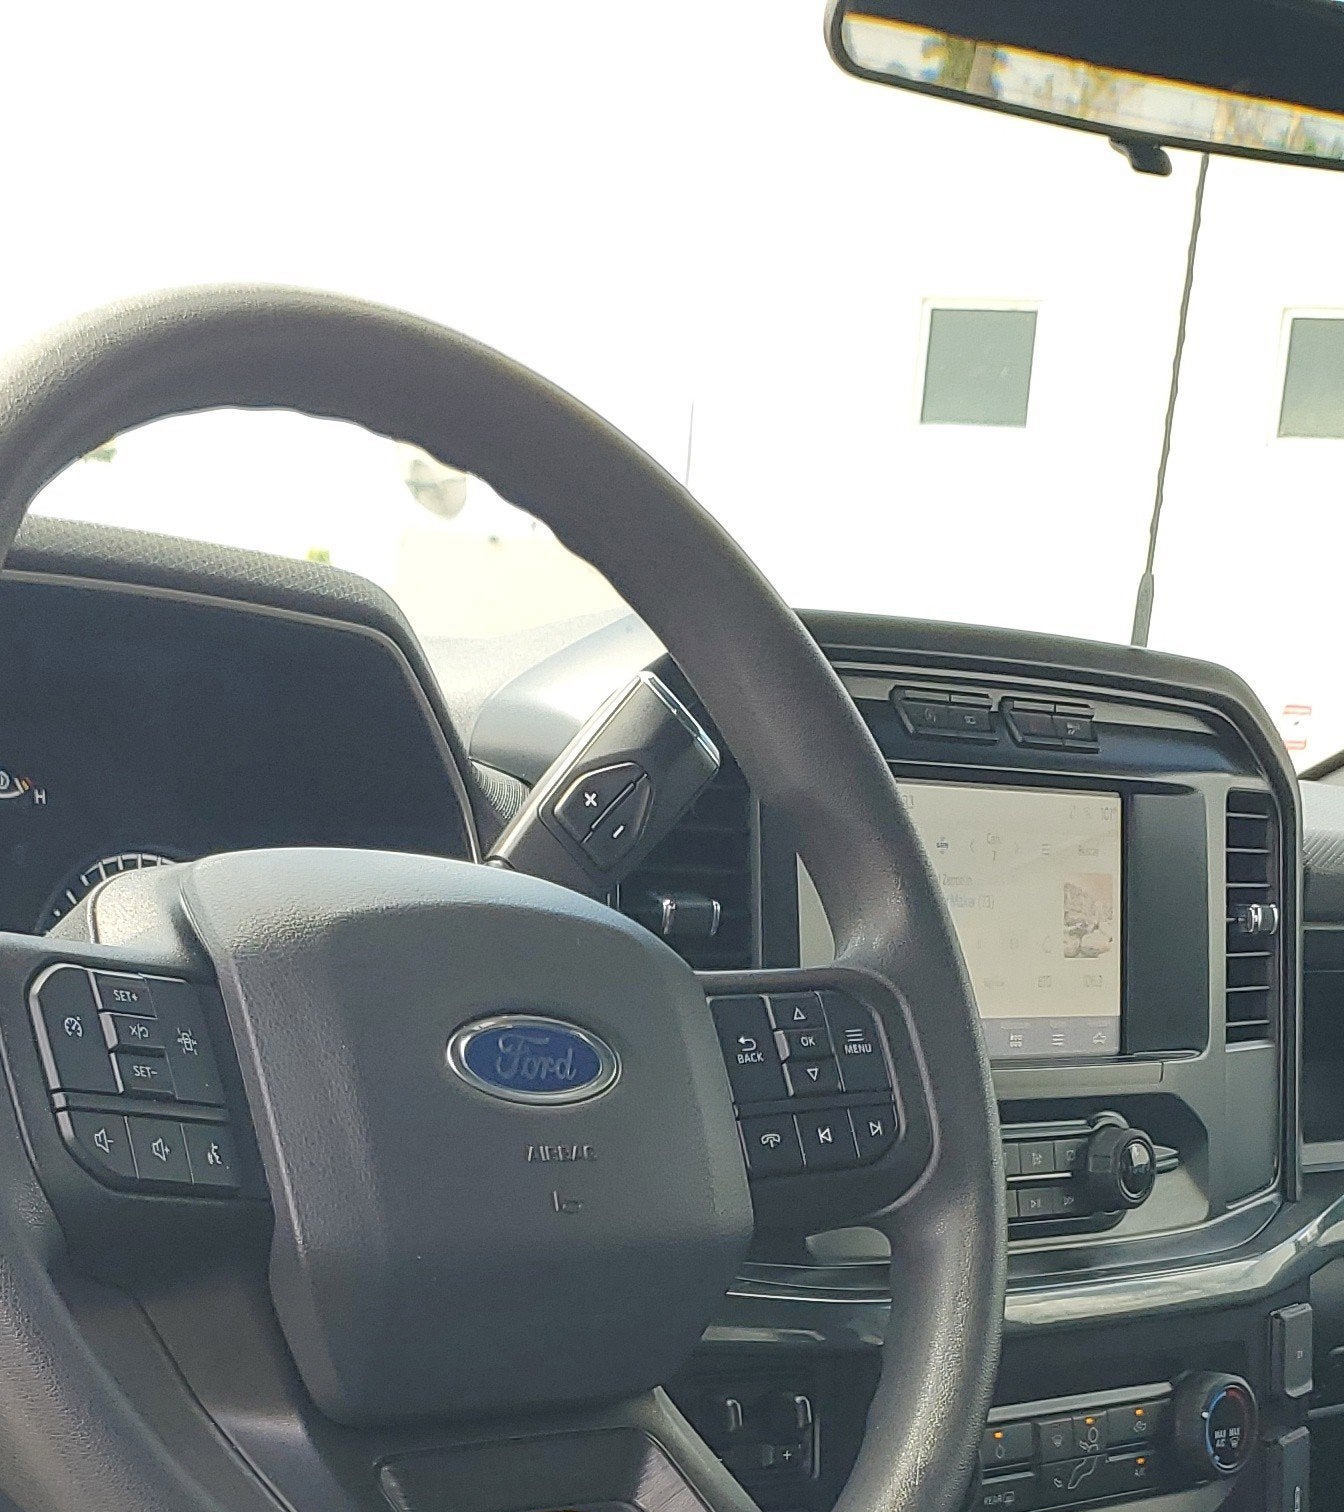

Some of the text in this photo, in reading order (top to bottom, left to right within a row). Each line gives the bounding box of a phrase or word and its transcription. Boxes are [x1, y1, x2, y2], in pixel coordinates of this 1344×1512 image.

[33, 788, 47, 805] H
[113, 989, 139, 1003] SET+
[800, 1036, 816, 1048] OK
[844, 1043, 873, 1055] MENU
[496, 1032, 577, 1081] Ford
[737, 1052, 765, 1065] BACK
